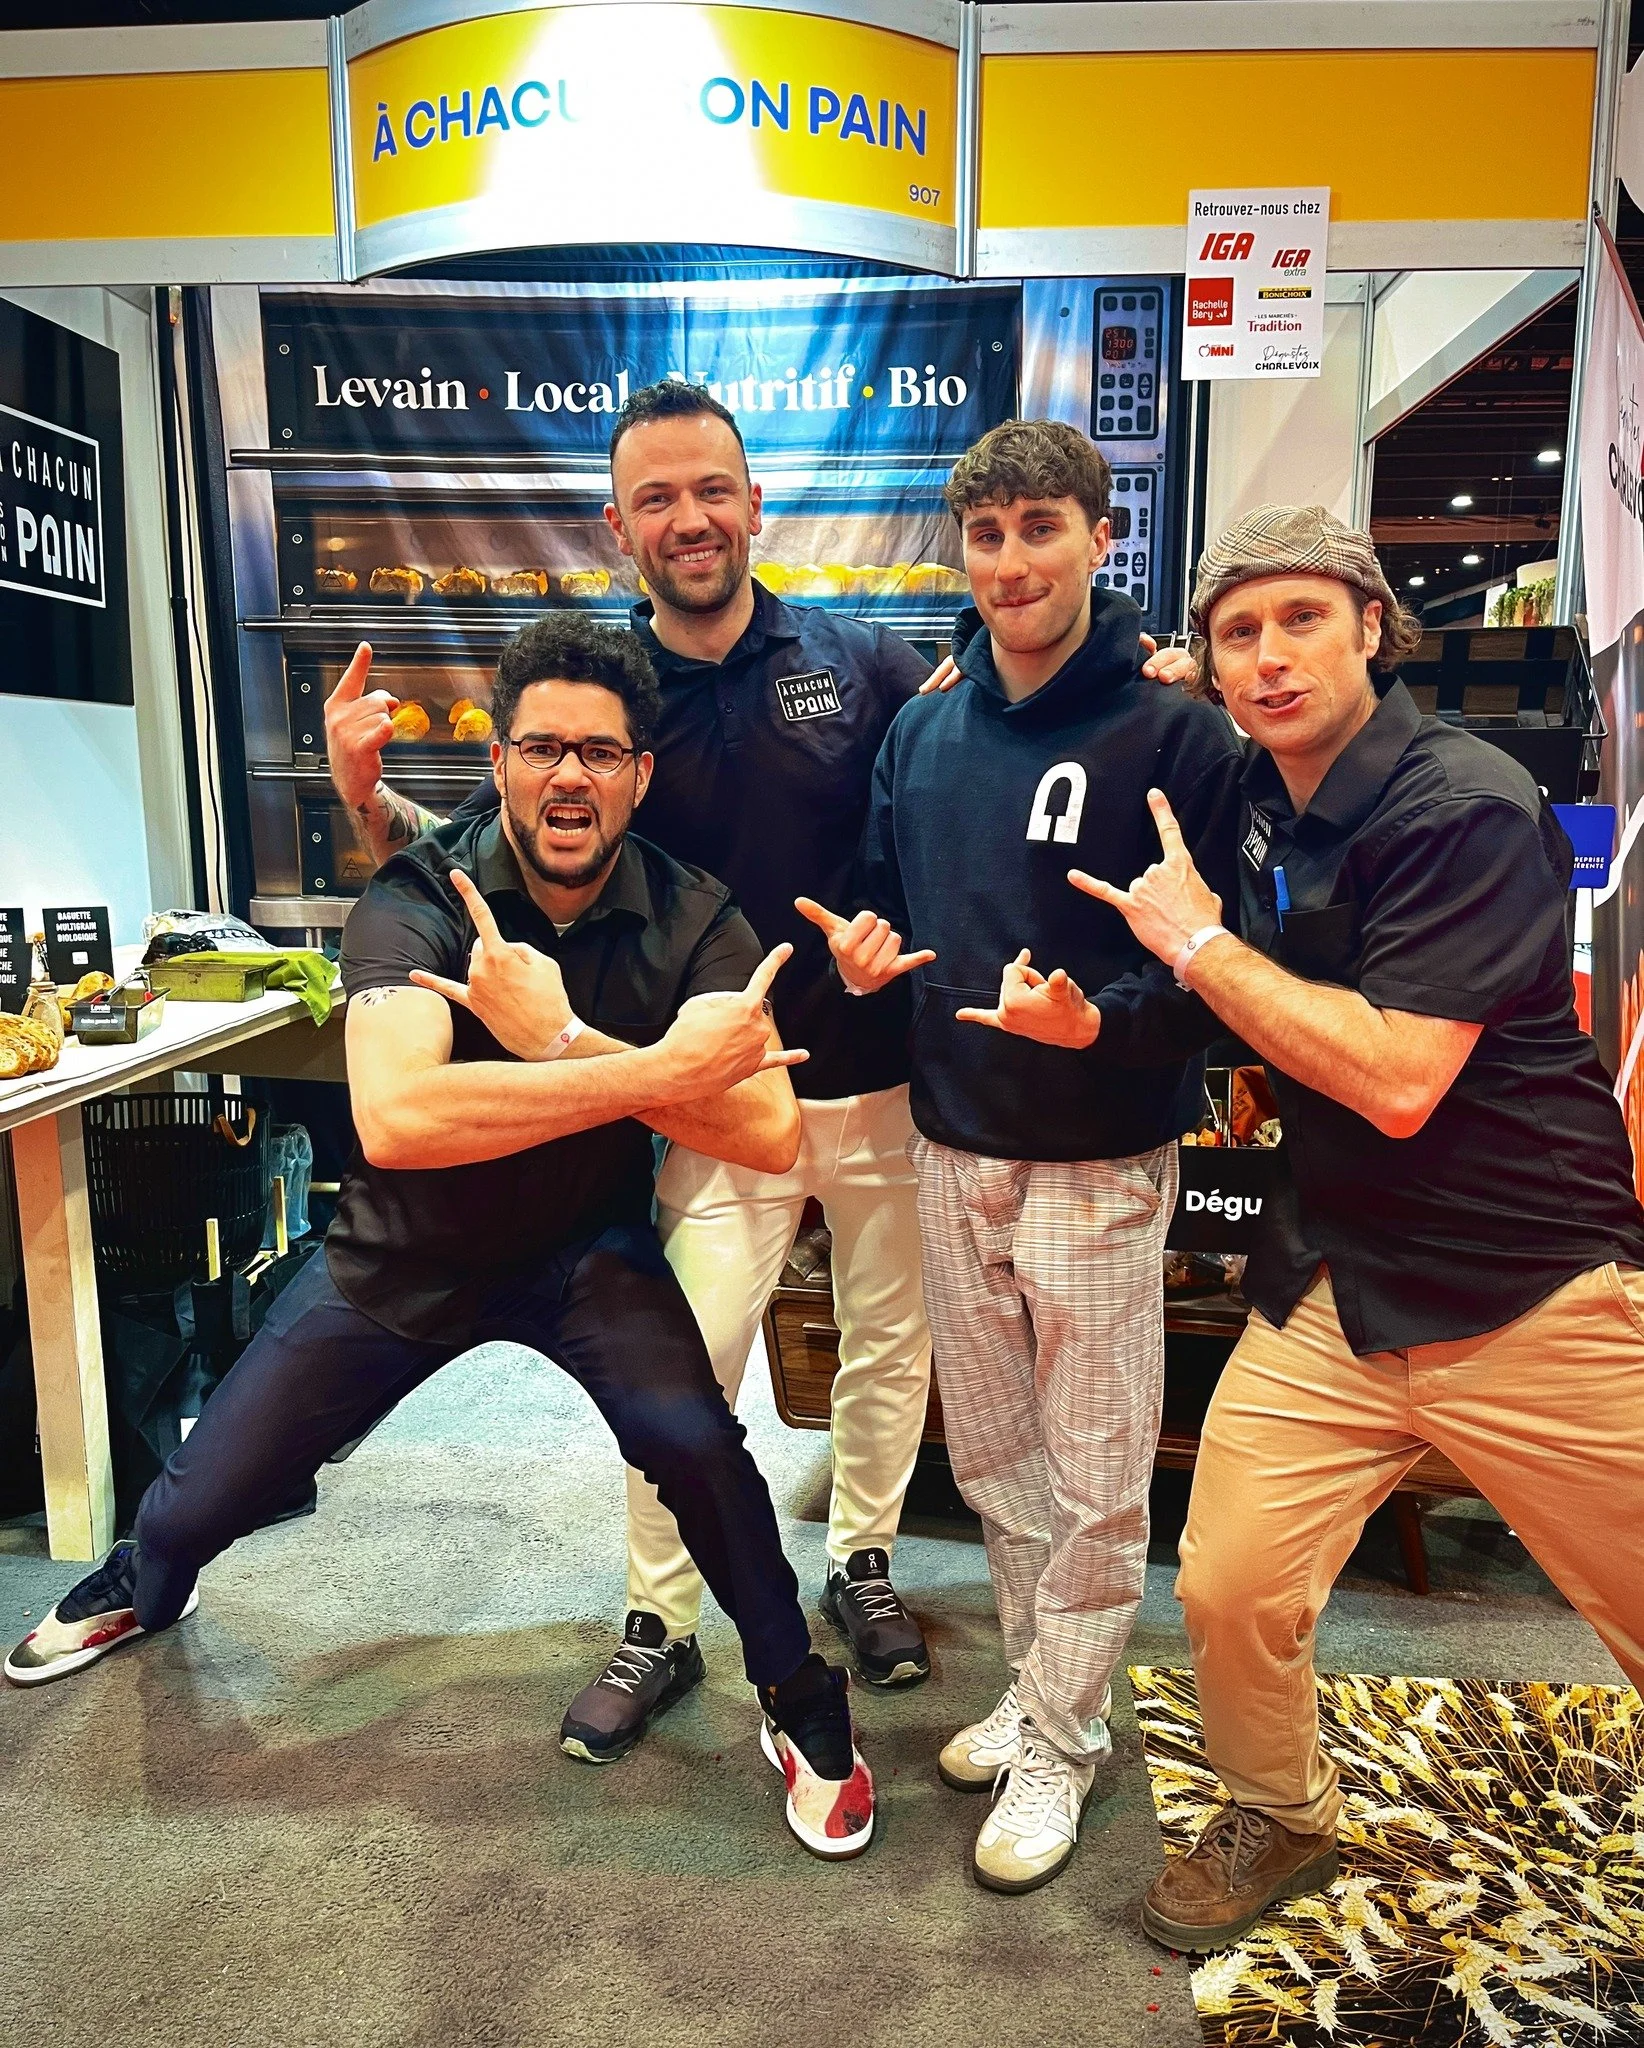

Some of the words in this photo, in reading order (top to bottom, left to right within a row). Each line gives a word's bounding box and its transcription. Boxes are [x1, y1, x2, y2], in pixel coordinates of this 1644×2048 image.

[372, 102, 397, 162] À
[810, 86, 926, 157] PAIN
[909, 184, 940, 207] 907
[1195, 201, 1289, 217] Retrouvez-nous
[1293, 199, 1320, 214] chez
[1199, 232, 1255, 260] IGA
[1271, 249, 1311, 268] IGA
[1283, 268, 1307, 276] extra
[1192, 300, 1228, 309] Rachelle
[1247, 320, 1302, 332] Tradition
[313, 365, 470, 411] Levain
[504, 368, 630, 413] Local
[888, 364, 967, 408] Bio
[12, 440, 93, 501] CHACUN
[789, 677, 830, 695] CHACUN
[57, 911, 92, 921] BAGUETTE
[55, 922, 97, 932] MULTIGRAIN
[56, 933, 98, 942] BIOLOGIQUE
[1185, 1188, 1263, 1222] Dégu
